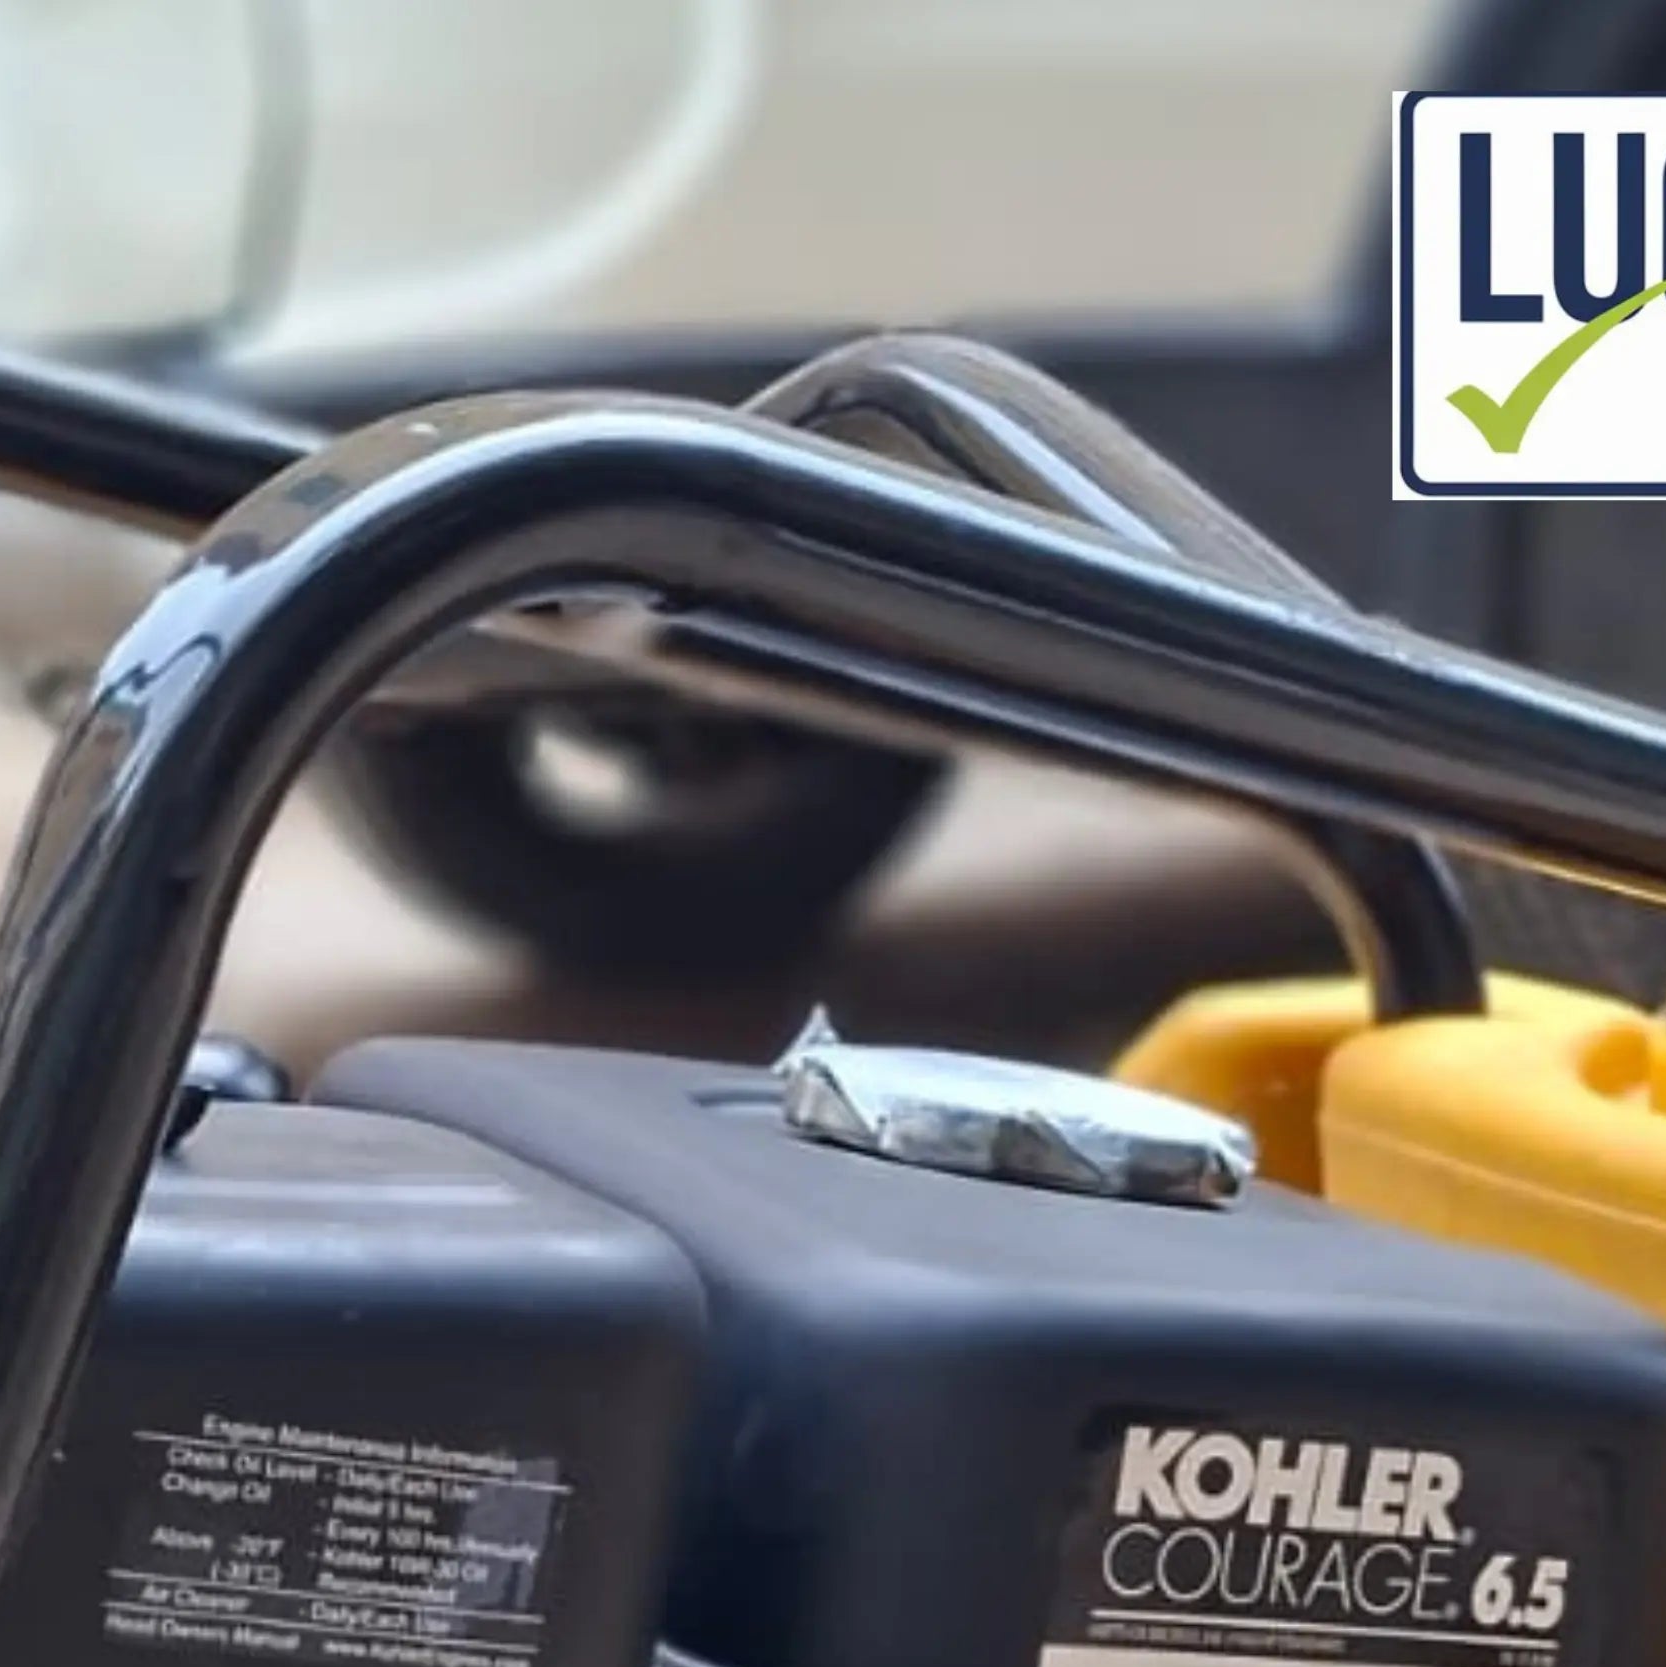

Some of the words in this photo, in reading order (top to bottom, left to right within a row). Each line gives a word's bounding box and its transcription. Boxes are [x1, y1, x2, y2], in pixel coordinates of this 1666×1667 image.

[1114, 1426, 1464, 1541] KOHLER
[1102, 1523, 1457, 1620] COURAGE
[1471, 1553, 1569, 1630] 6.5
